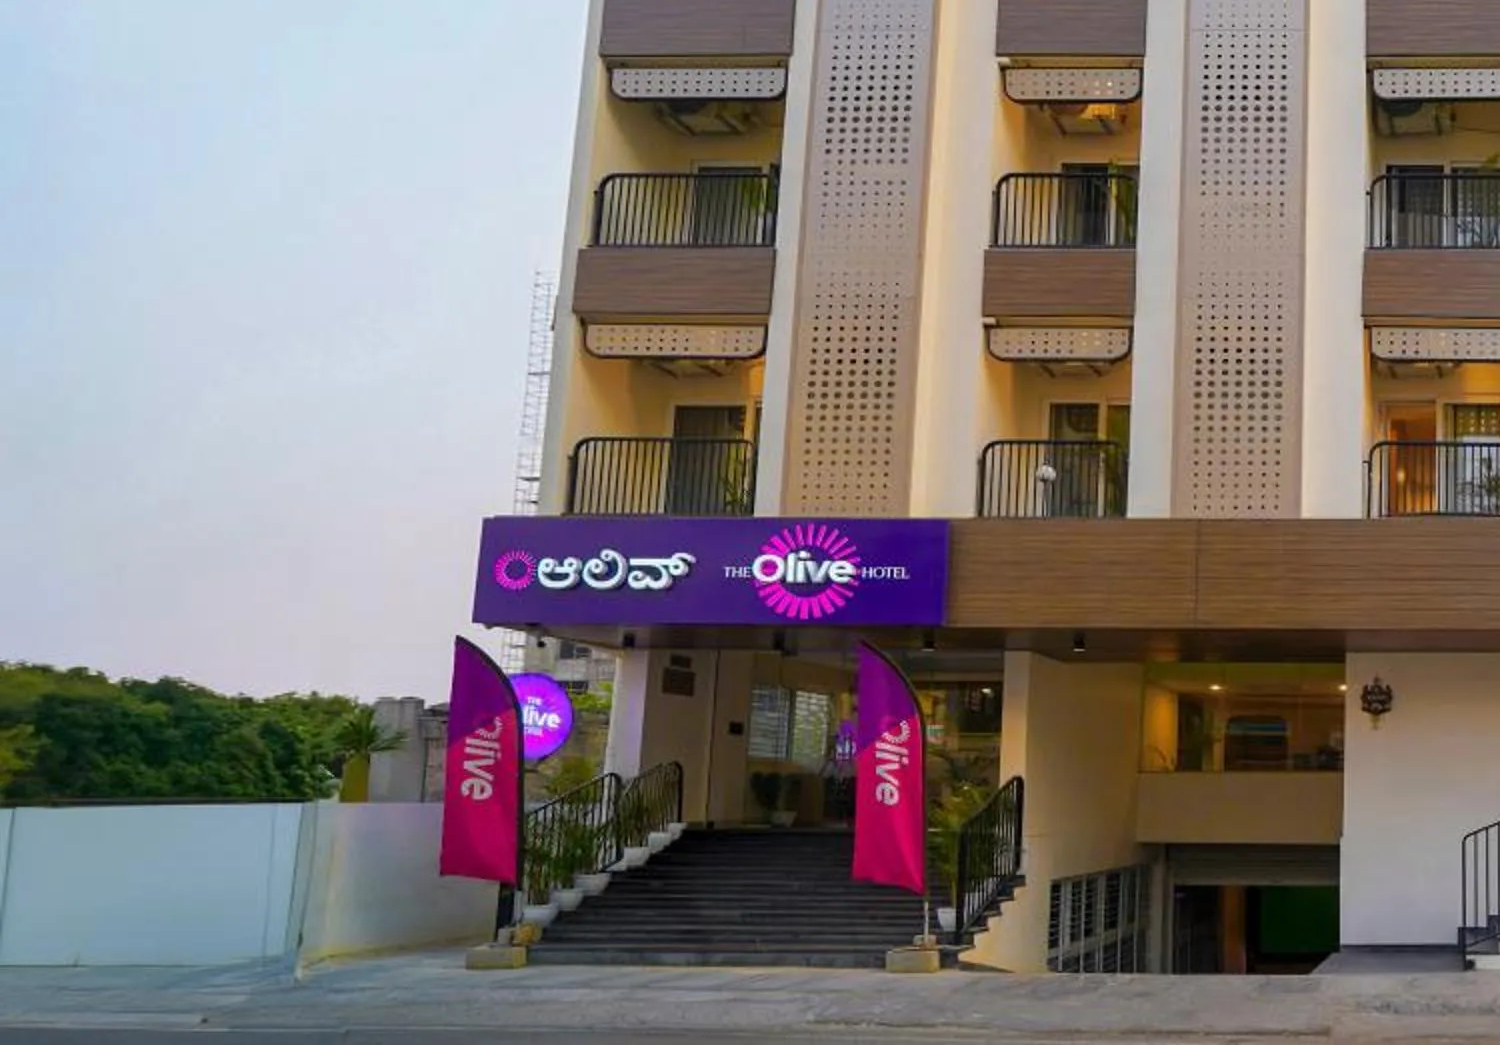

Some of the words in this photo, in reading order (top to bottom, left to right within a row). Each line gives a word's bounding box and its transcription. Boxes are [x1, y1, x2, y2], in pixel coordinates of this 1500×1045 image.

[537, 548, 697, 590] ಆಲಿವ್
[724, 566, 752, 578] THE
[752, 550, 858, 584] Olive
[861, 566, 911, 580] HOTEL
[522, 705, 561, 728] live
